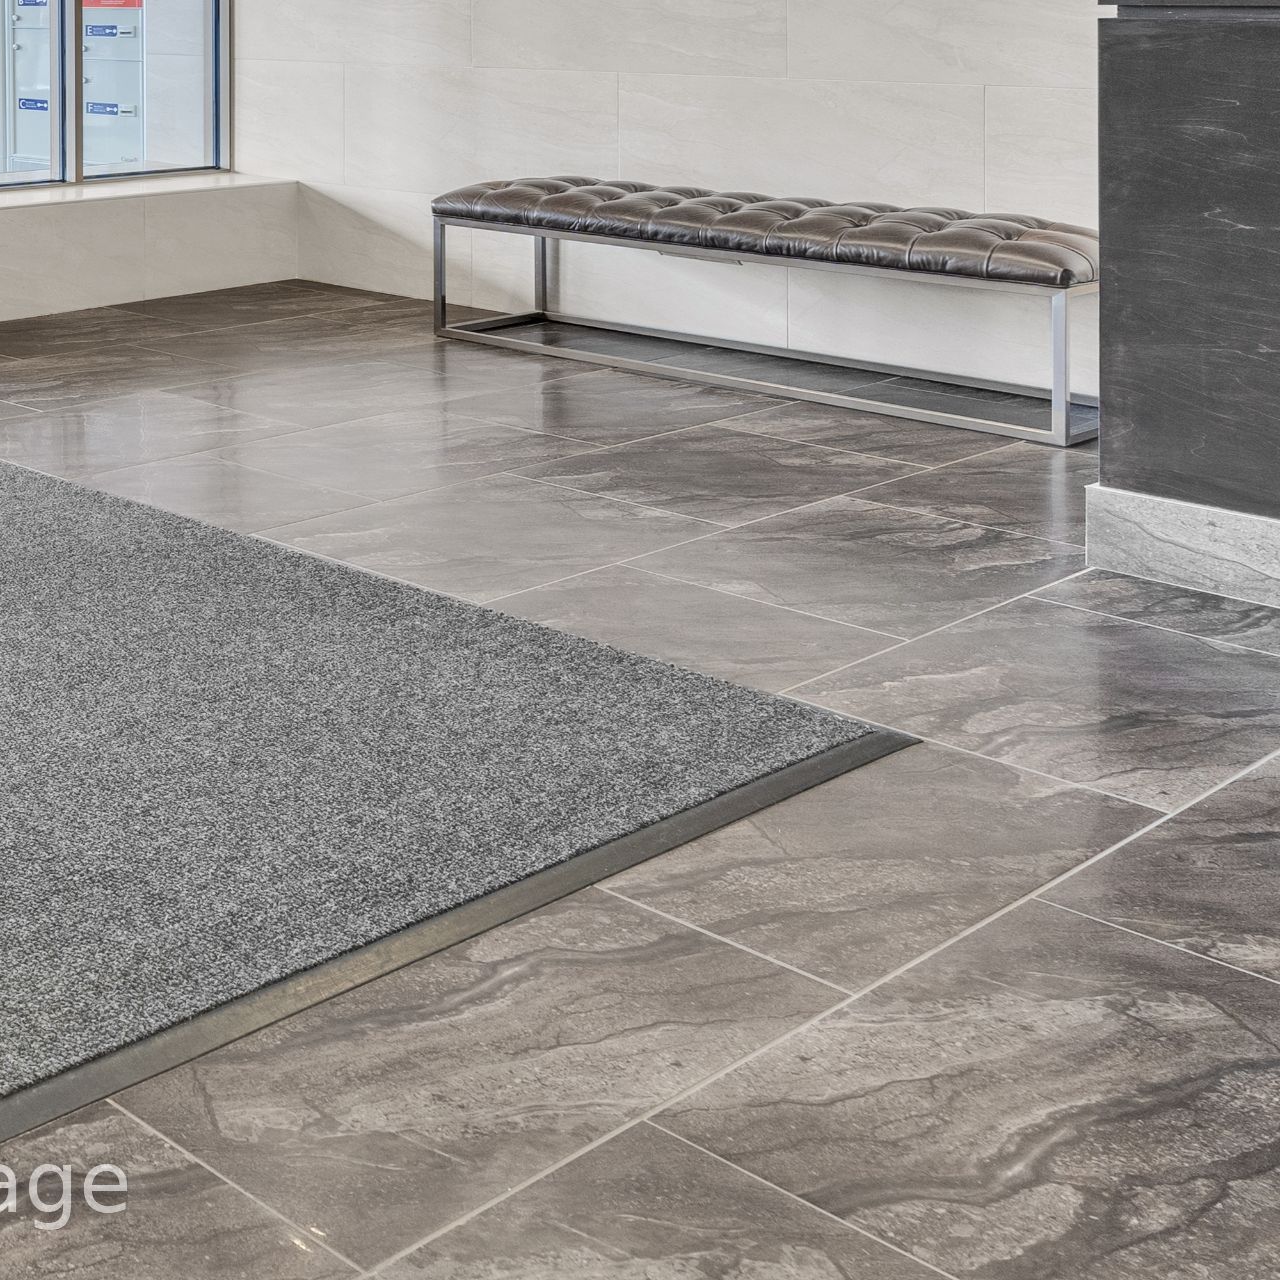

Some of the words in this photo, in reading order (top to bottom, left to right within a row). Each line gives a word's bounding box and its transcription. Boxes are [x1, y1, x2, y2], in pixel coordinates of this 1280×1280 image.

[87, 25, 92, 36] E
[19, 99, 26, 109] C
[88, 103, 93, 113] F
